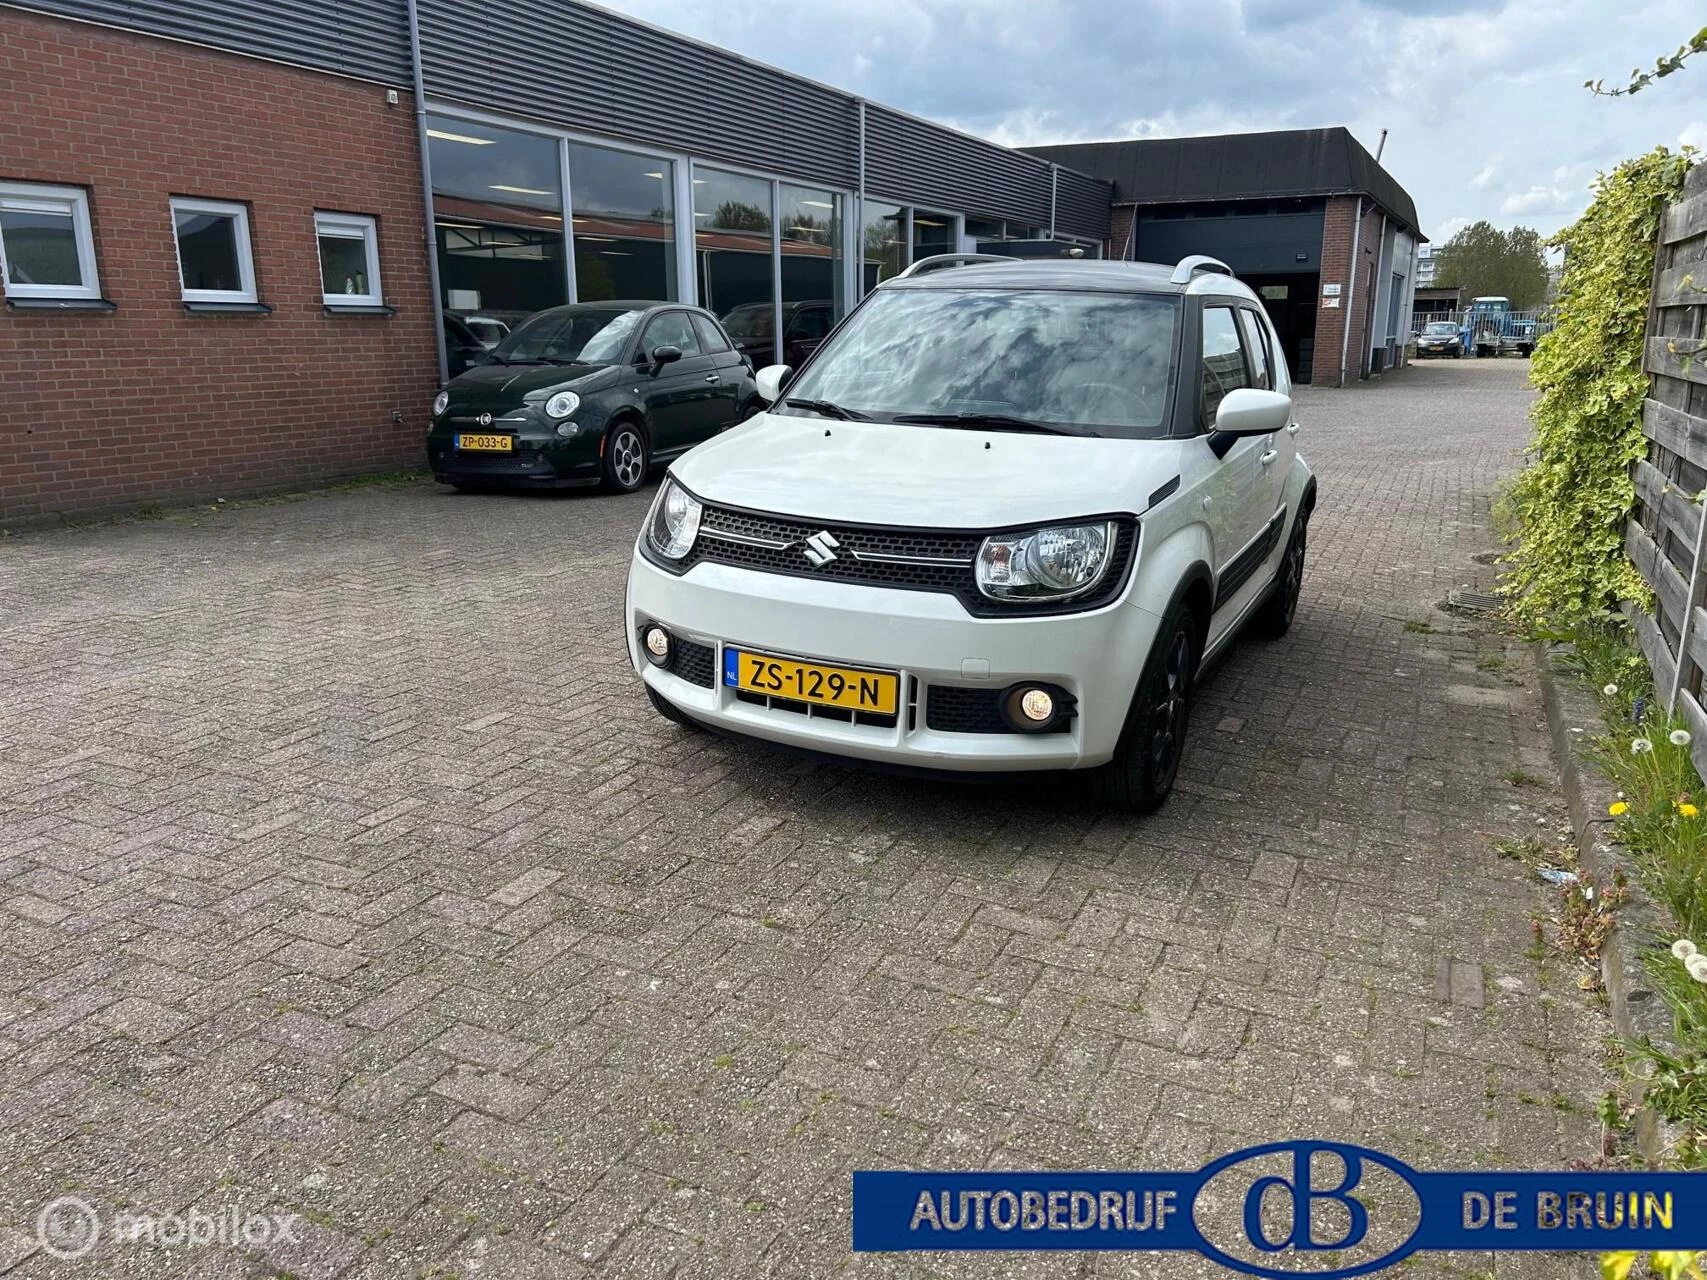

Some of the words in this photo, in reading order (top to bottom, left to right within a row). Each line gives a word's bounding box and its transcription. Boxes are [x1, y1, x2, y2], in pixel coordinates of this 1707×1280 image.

[462, 436, 508, 449] ZP-033-G
[726, 671, 737, 681] NL
[750, 659, 879, 706] ZS-129-N
